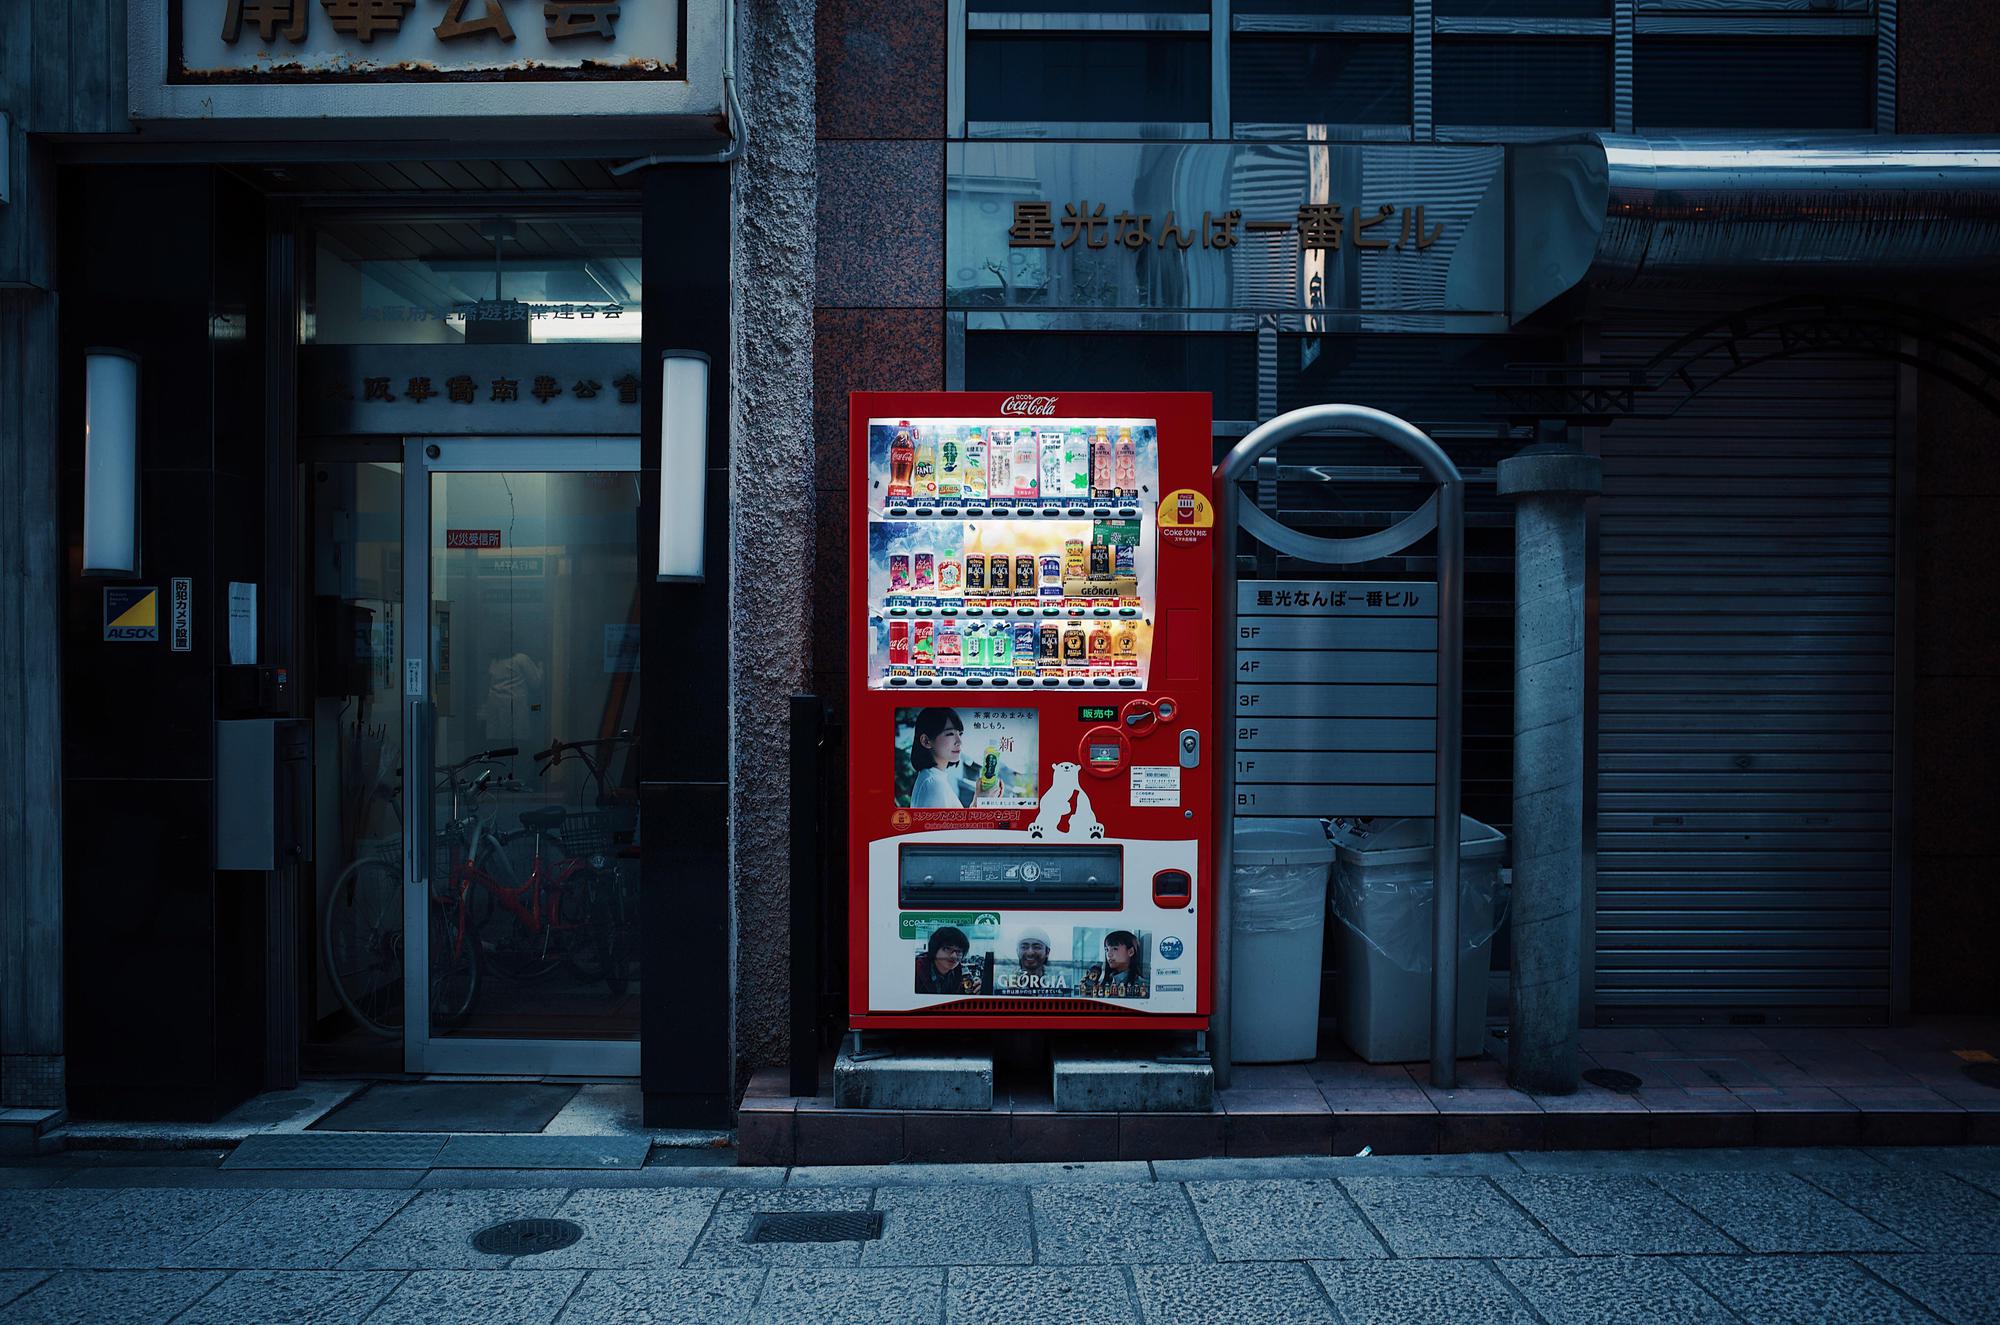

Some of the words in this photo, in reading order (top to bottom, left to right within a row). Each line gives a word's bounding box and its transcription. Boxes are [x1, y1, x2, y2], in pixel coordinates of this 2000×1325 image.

[1008, 200, 1445, 250] 星光なんば一番ビル
[1000, 396, 1059, 415] Coca-Cola
[1163, 528, 1183, 536] Coke
[448, 532, 499, 546] 火災受信所
[1092, 552, 1108, 560] BLACK
[1257, 590, 1419, 607] 星光なんば一番ビル
[175, 581, 188, 648] 防犯カメラ設置
[107, 628, 155, 639] ALSOK
[1240, 627, 1261, 638] 5F
[1041, 637, 1057, 645] BLACK
[1239, 661, 1260, 672] 4F
[1239, 695, 1260, 706] 3F
[974, 711, 1033, 719] 茶葉のあまみを
[1082, 708, 1114, 719] 販売中
[1238, 728, 1258, 739] 2F
[999, 736, 1015, 752] 新
[1237, 761, 1256, 773] 1F
[1237, 794, 1256, 805] B1
[997, 971, 1067, 989] GEORGIA
